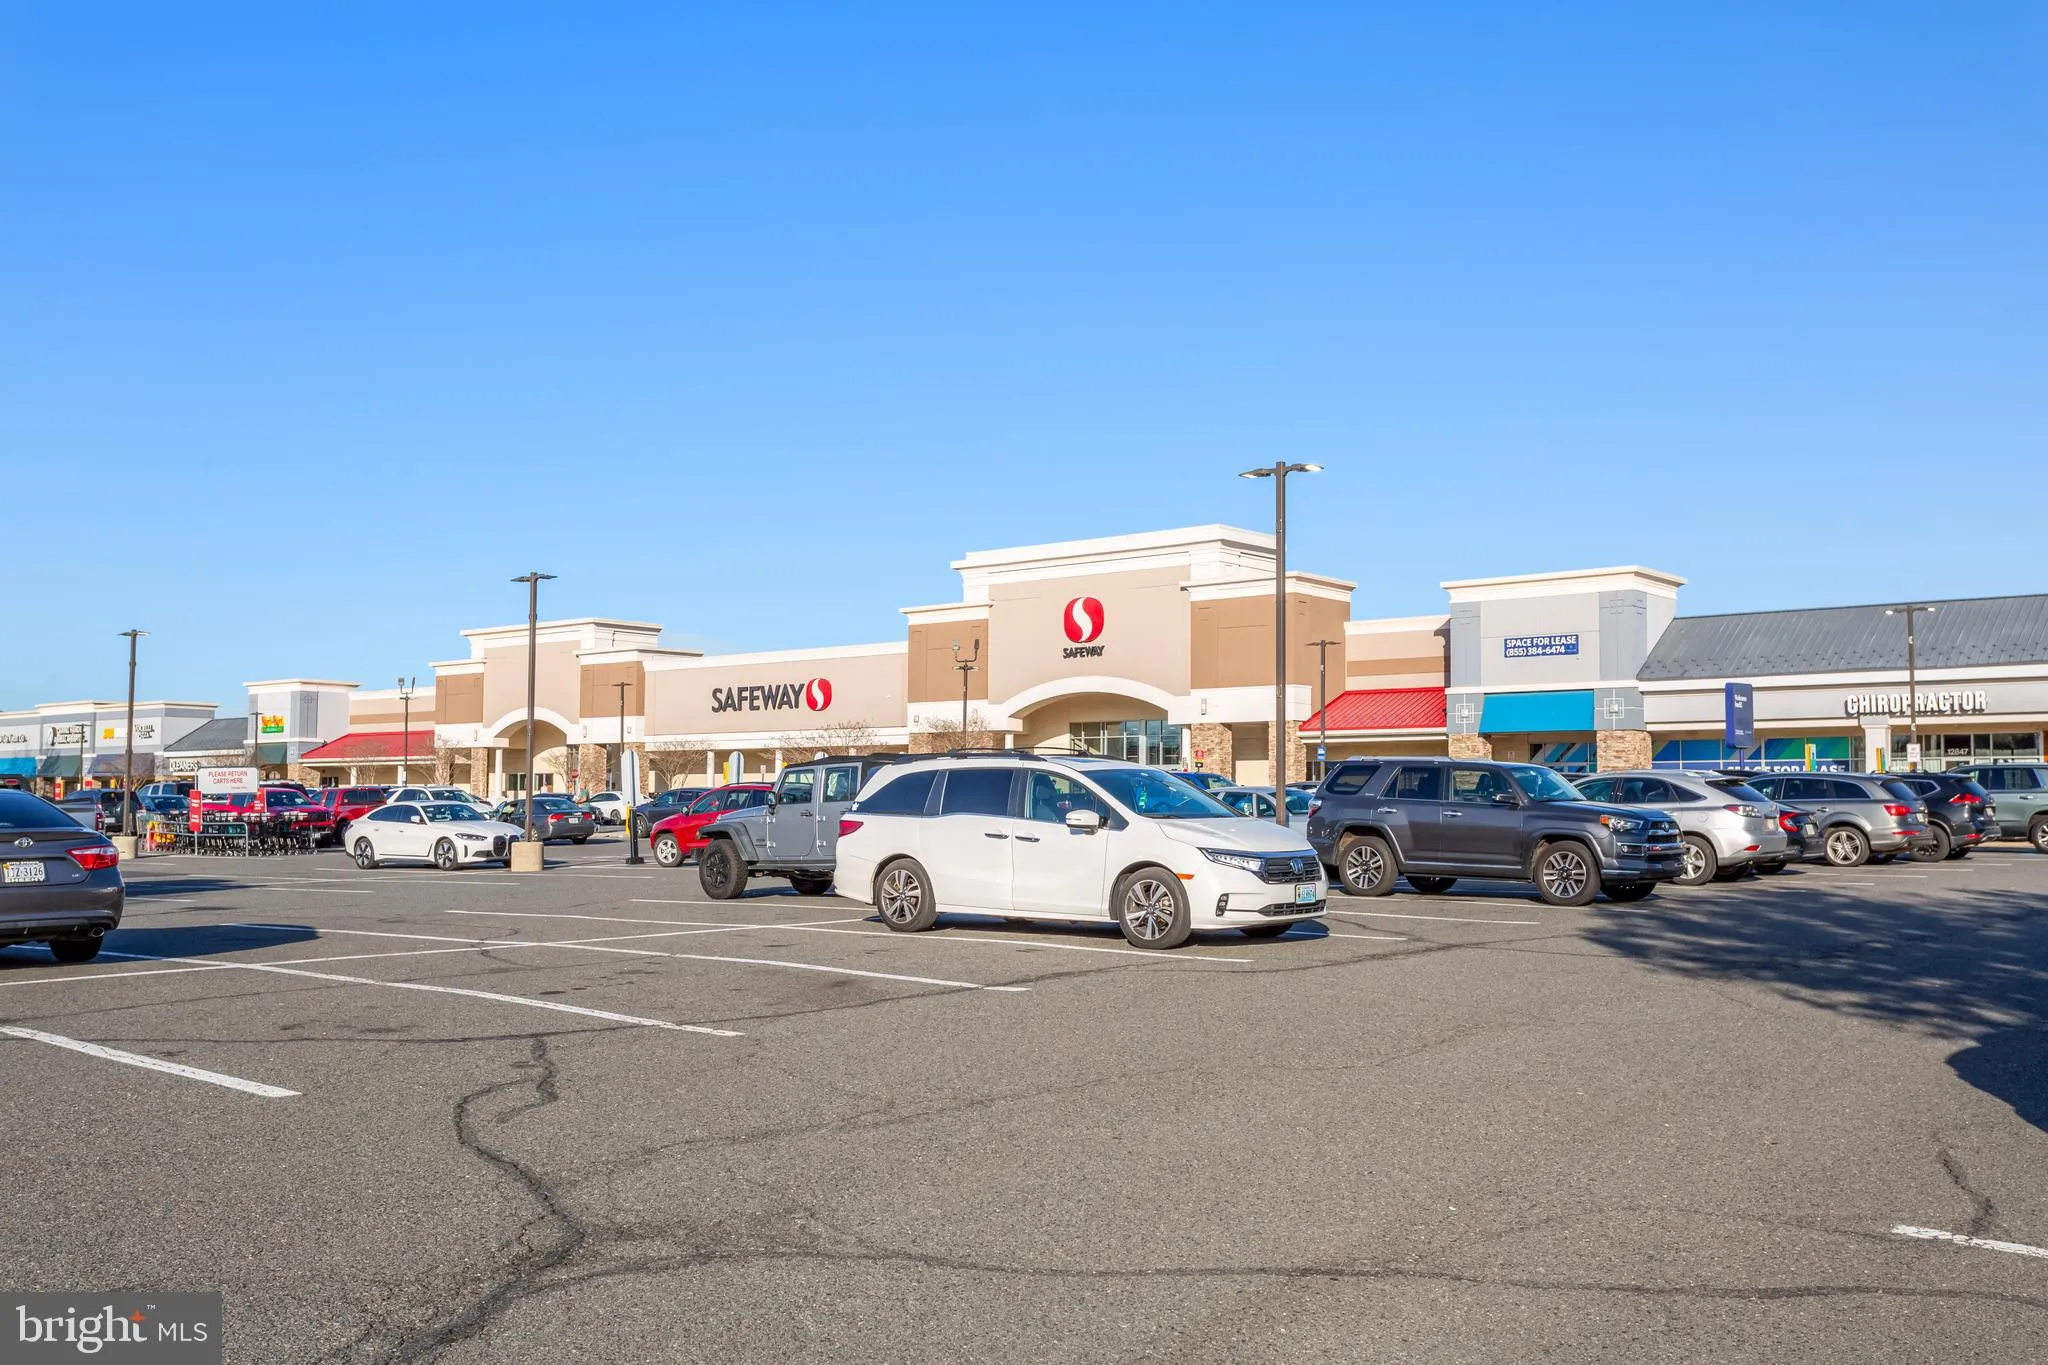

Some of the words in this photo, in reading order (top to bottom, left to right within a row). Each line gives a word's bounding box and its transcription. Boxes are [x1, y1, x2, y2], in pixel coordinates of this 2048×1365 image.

[1506, 638, 1532, 648] SPACE
[1533, 637, 1550, 646] FOR
[1551, 636, 1577, 645] LEASE
[1062, 645, 1106, 660] SAFEWAY
[1506, 647, 1527, 657] (855)
[1527, 646, 1565, 656] 384-6474
[711, 683, 806, 713] SAFEWAY
[1846, 690, 1988, 714] CHIROPRACTOR
